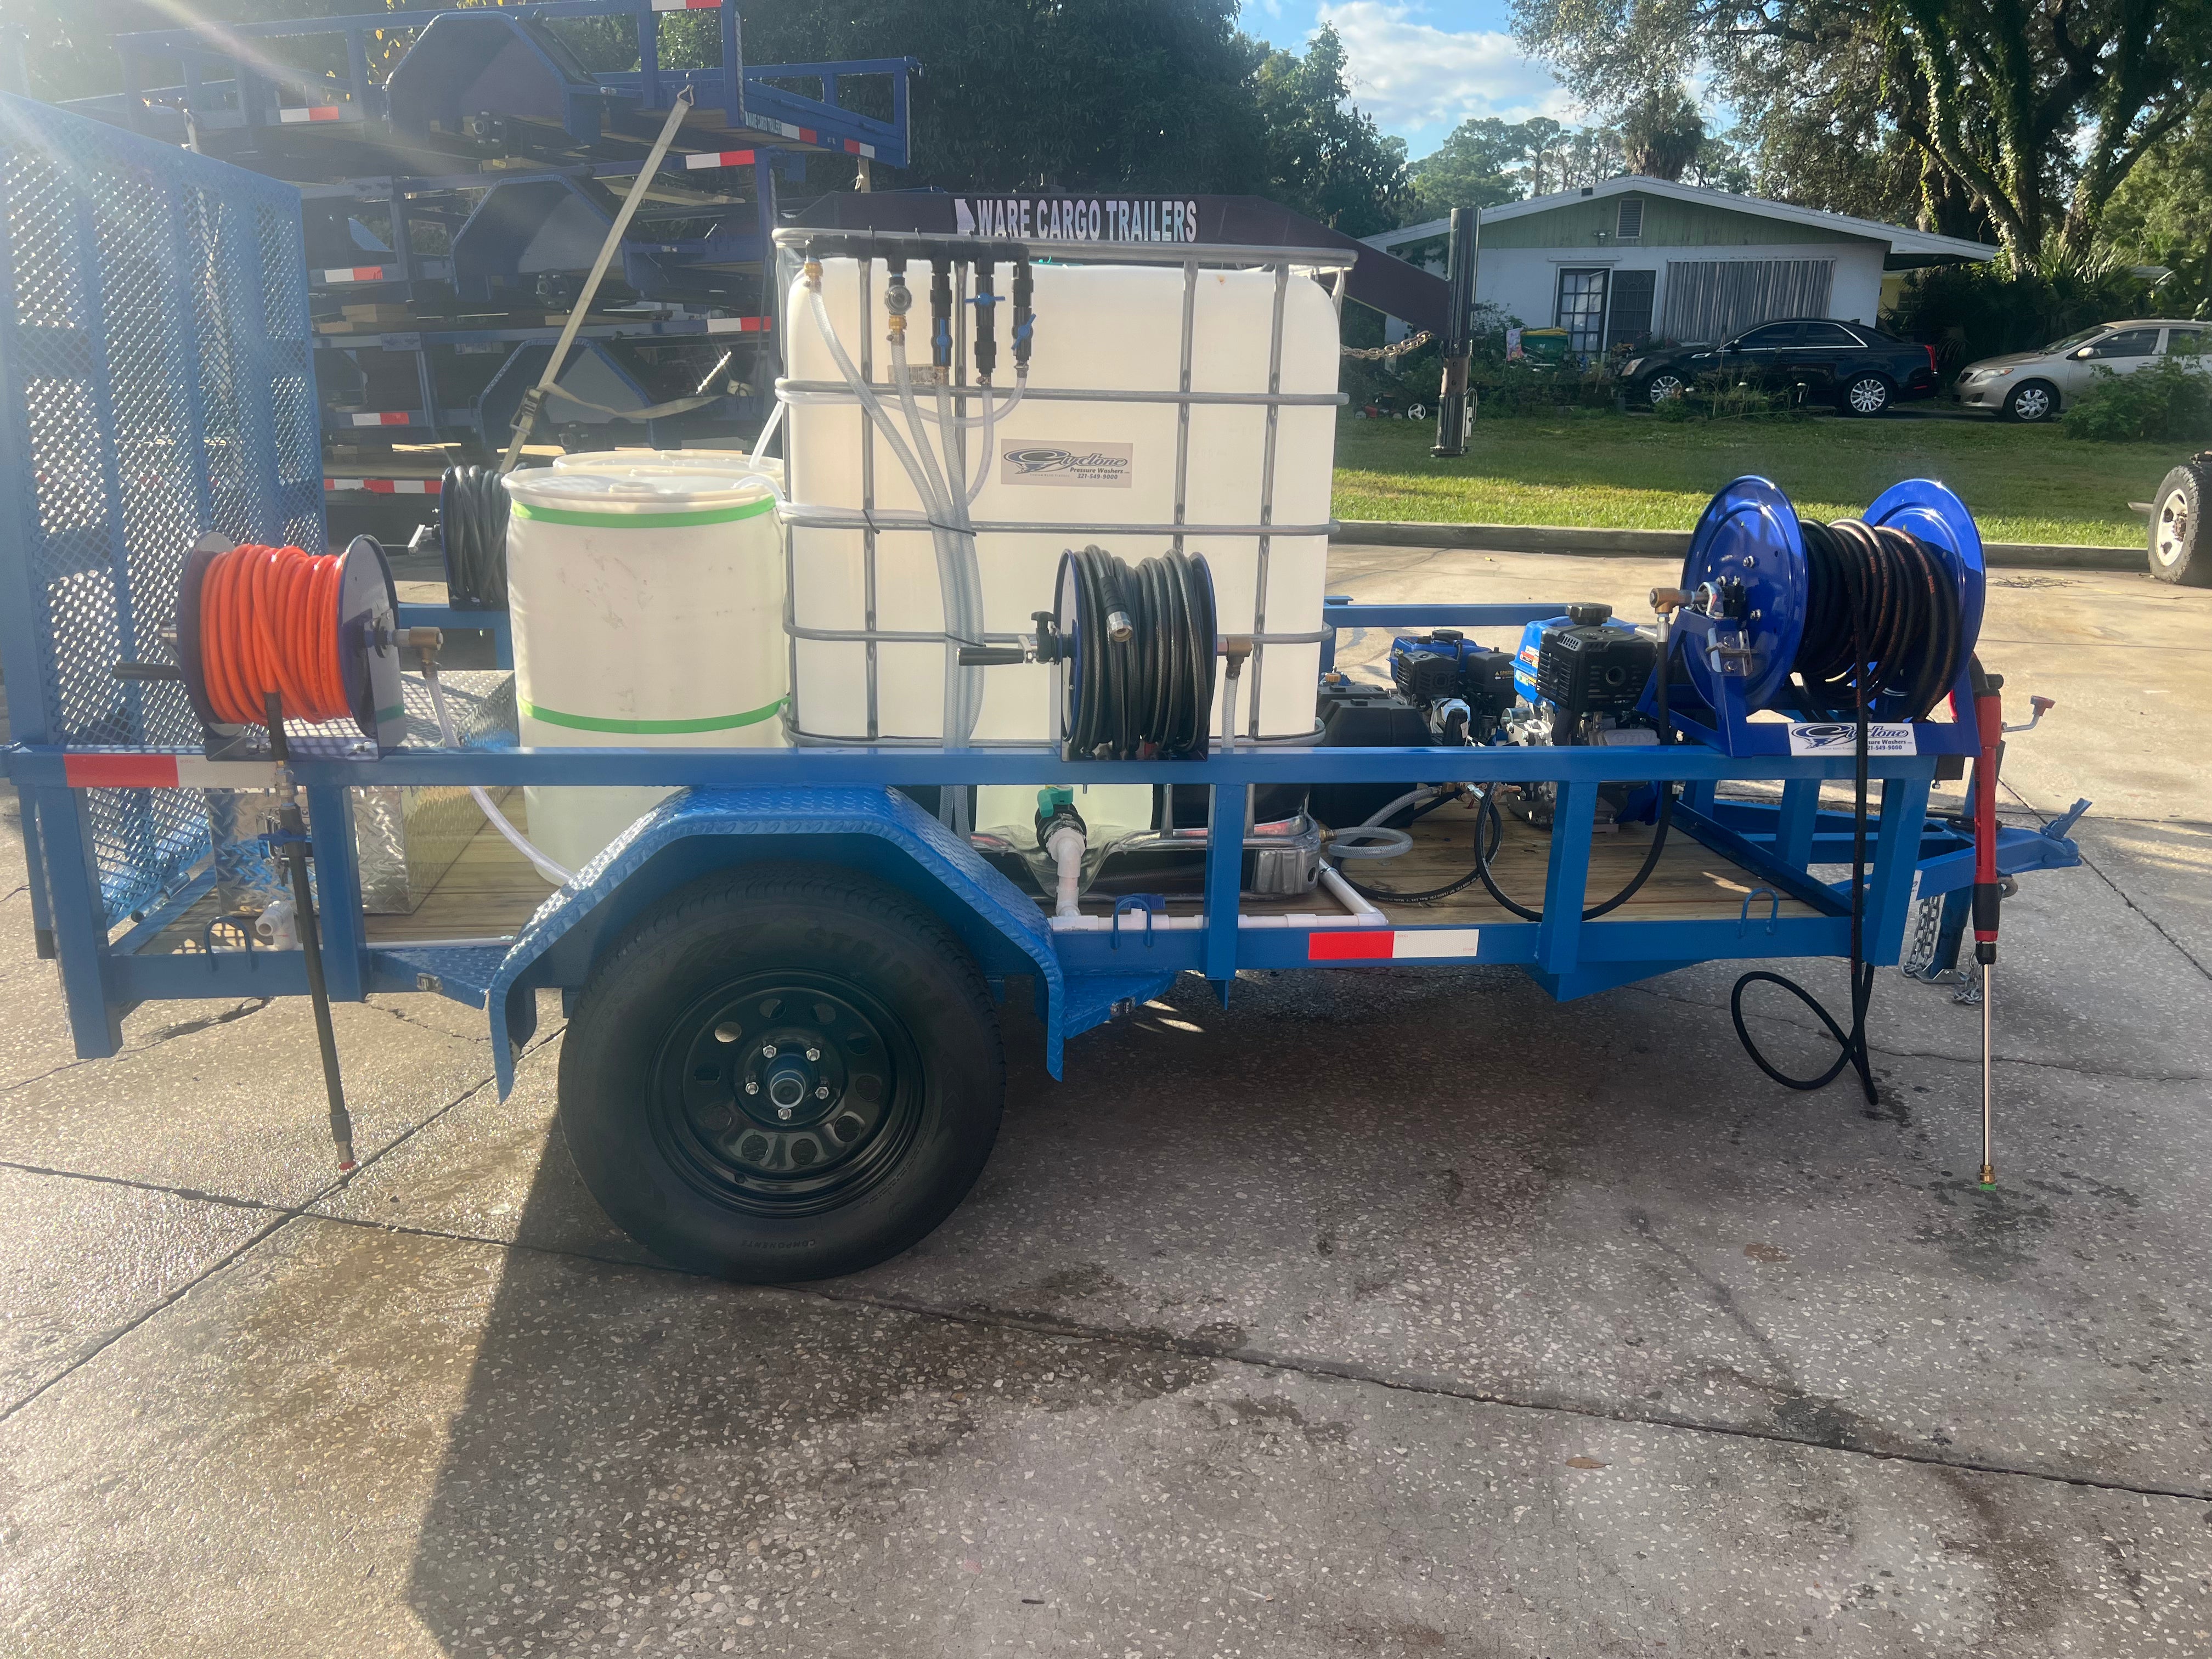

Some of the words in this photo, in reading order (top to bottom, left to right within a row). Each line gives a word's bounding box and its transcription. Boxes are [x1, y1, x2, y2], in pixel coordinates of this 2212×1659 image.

[977, 199, 1030, 238] WARE
[1036, 199, 1100, 241] CARGO
[1105, 200, 1197, 242] TRAILERS
[1003, 448, 1128, 474] Cyclone
